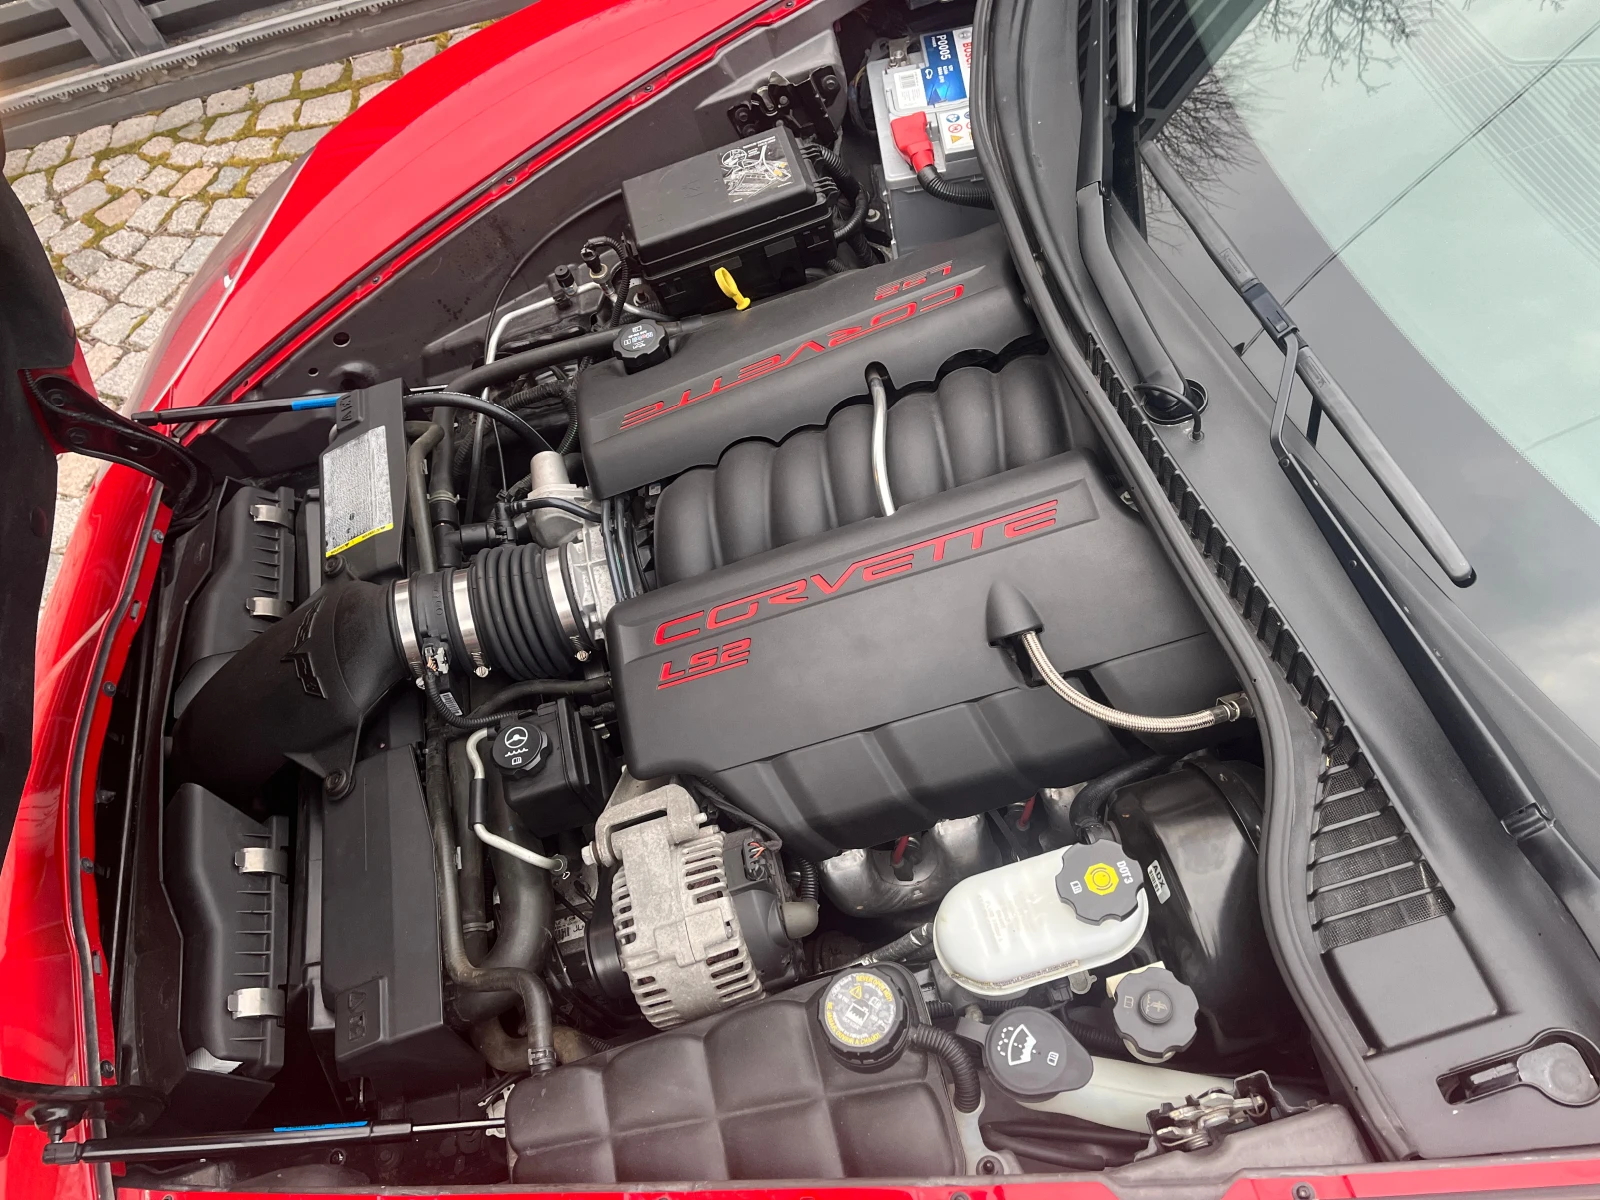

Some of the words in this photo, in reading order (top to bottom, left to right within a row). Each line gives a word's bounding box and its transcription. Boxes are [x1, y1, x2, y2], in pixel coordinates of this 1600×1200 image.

[936, 34, 952, 60] P0005
[962, 42, 973, 69] BOSC
[874, 261, 953, 301] LS2
[618, 283, 965, 430] CORVETTE
[654, 498, 1058, 646] CORVETTE
[658, 638, 752, 686] LS2
[1151, 864, 1166, 889] ADX
